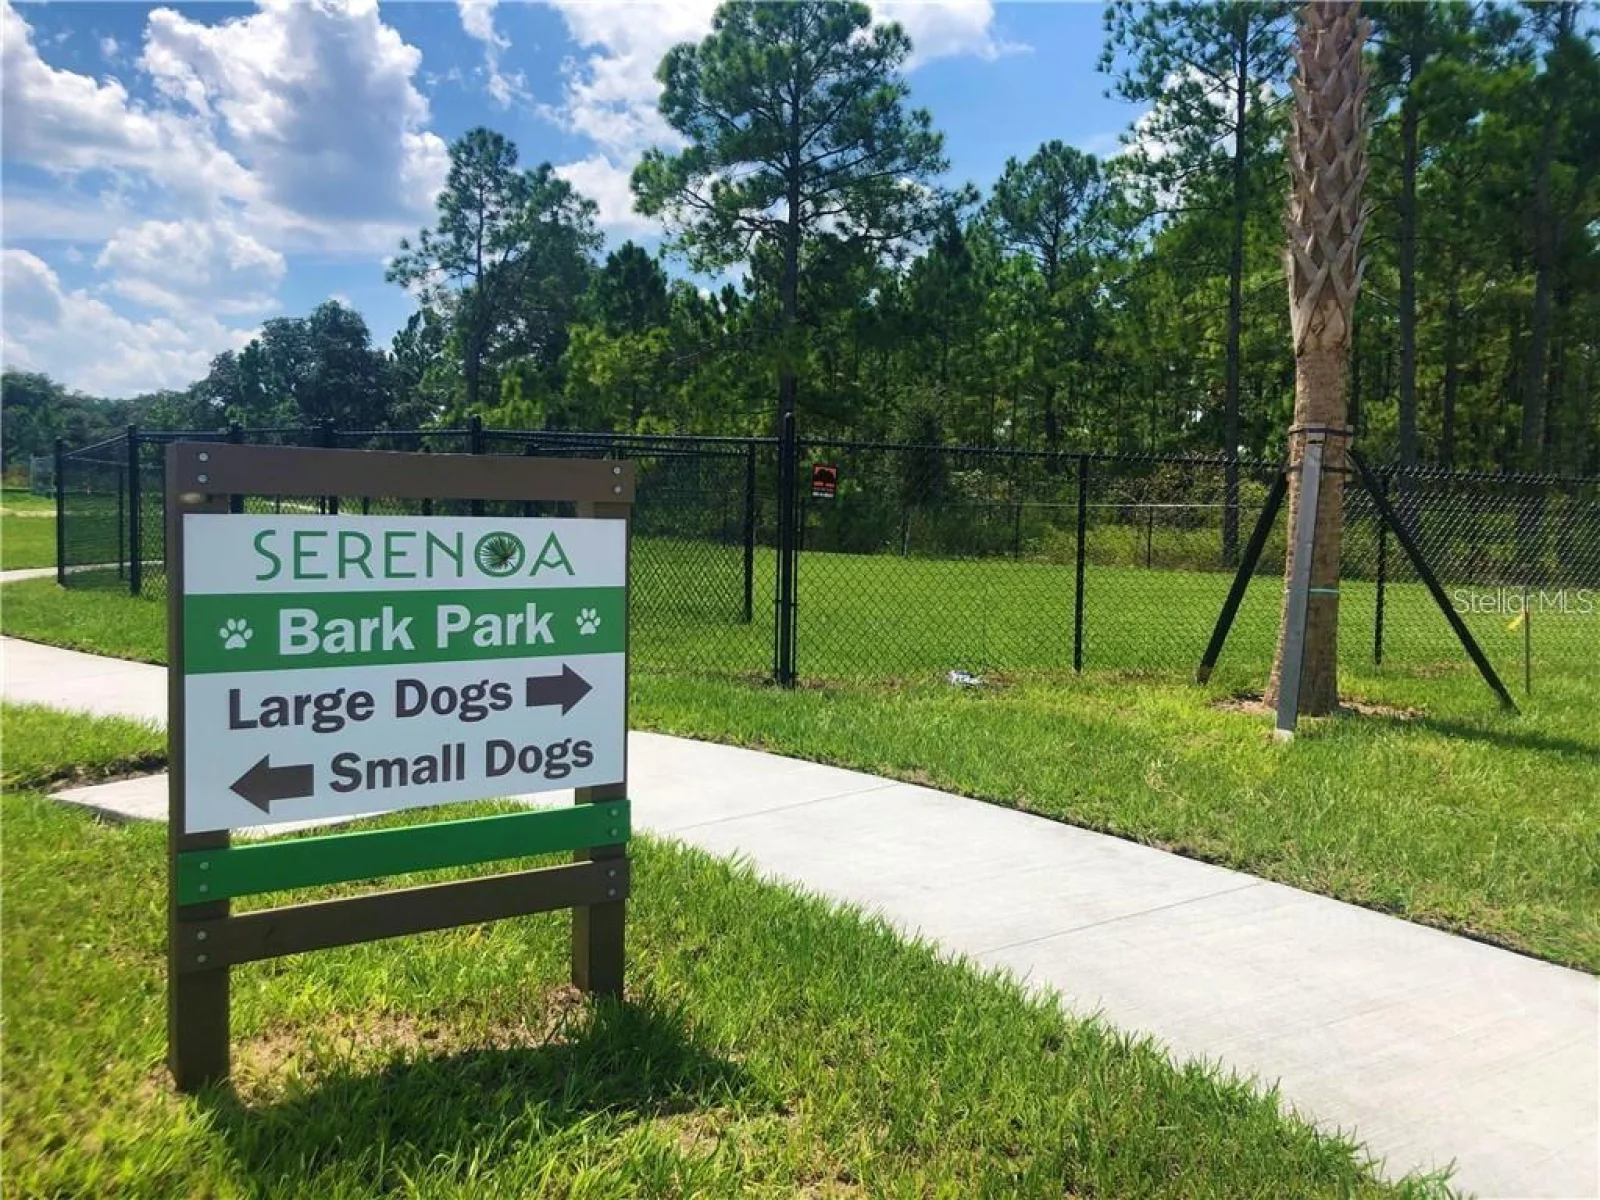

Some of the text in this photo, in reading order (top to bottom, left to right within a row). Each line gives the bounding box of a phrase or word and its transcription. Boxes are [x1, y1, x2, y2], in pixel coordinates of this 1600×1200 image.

[253, 529, 575, 581] SERENOA
[278, 602, 555, 656] Bark Park
[228, 678, 513, 734] Large Dogs
[329, 737, 595, 793] Small Dogs
